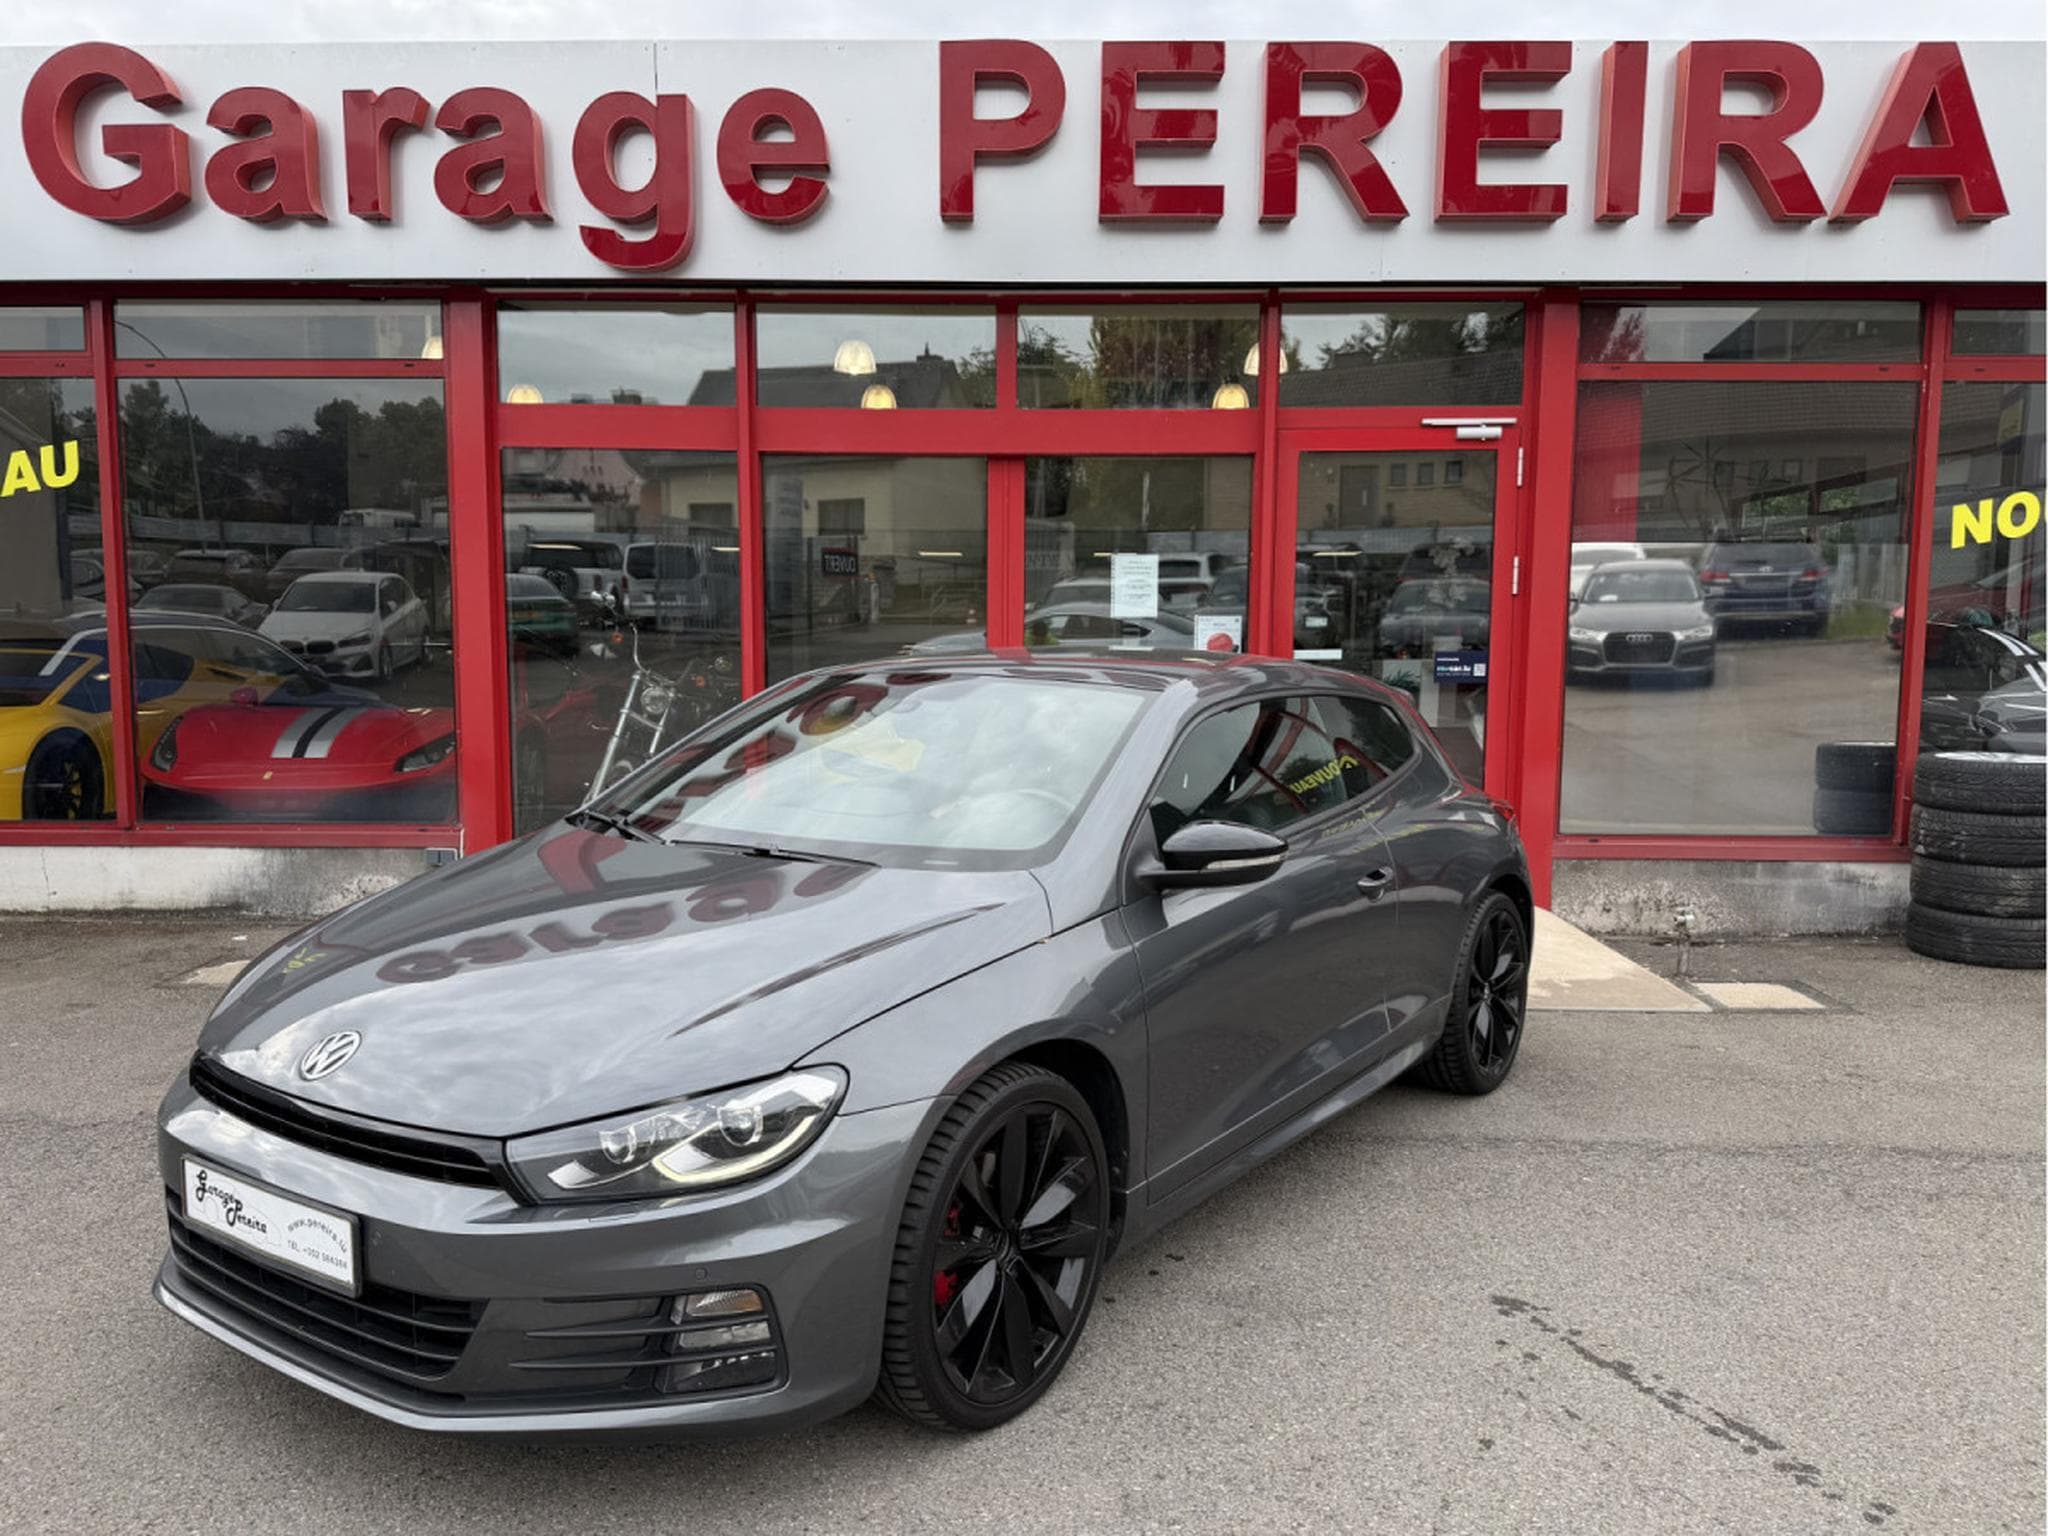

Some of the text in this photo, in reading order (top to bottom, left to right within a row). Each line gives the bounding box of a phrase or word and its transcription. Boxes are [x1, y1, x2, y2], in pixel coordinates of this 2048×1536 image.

[21, 38, 2010, 272] Garage PEREIRA
[0, 439, 79, 498] AU
[1951, 490, 2041, 549] NO
[195, 1169, 235, 1209] Garage
[225, 1199, 267, 1233] Pereira
